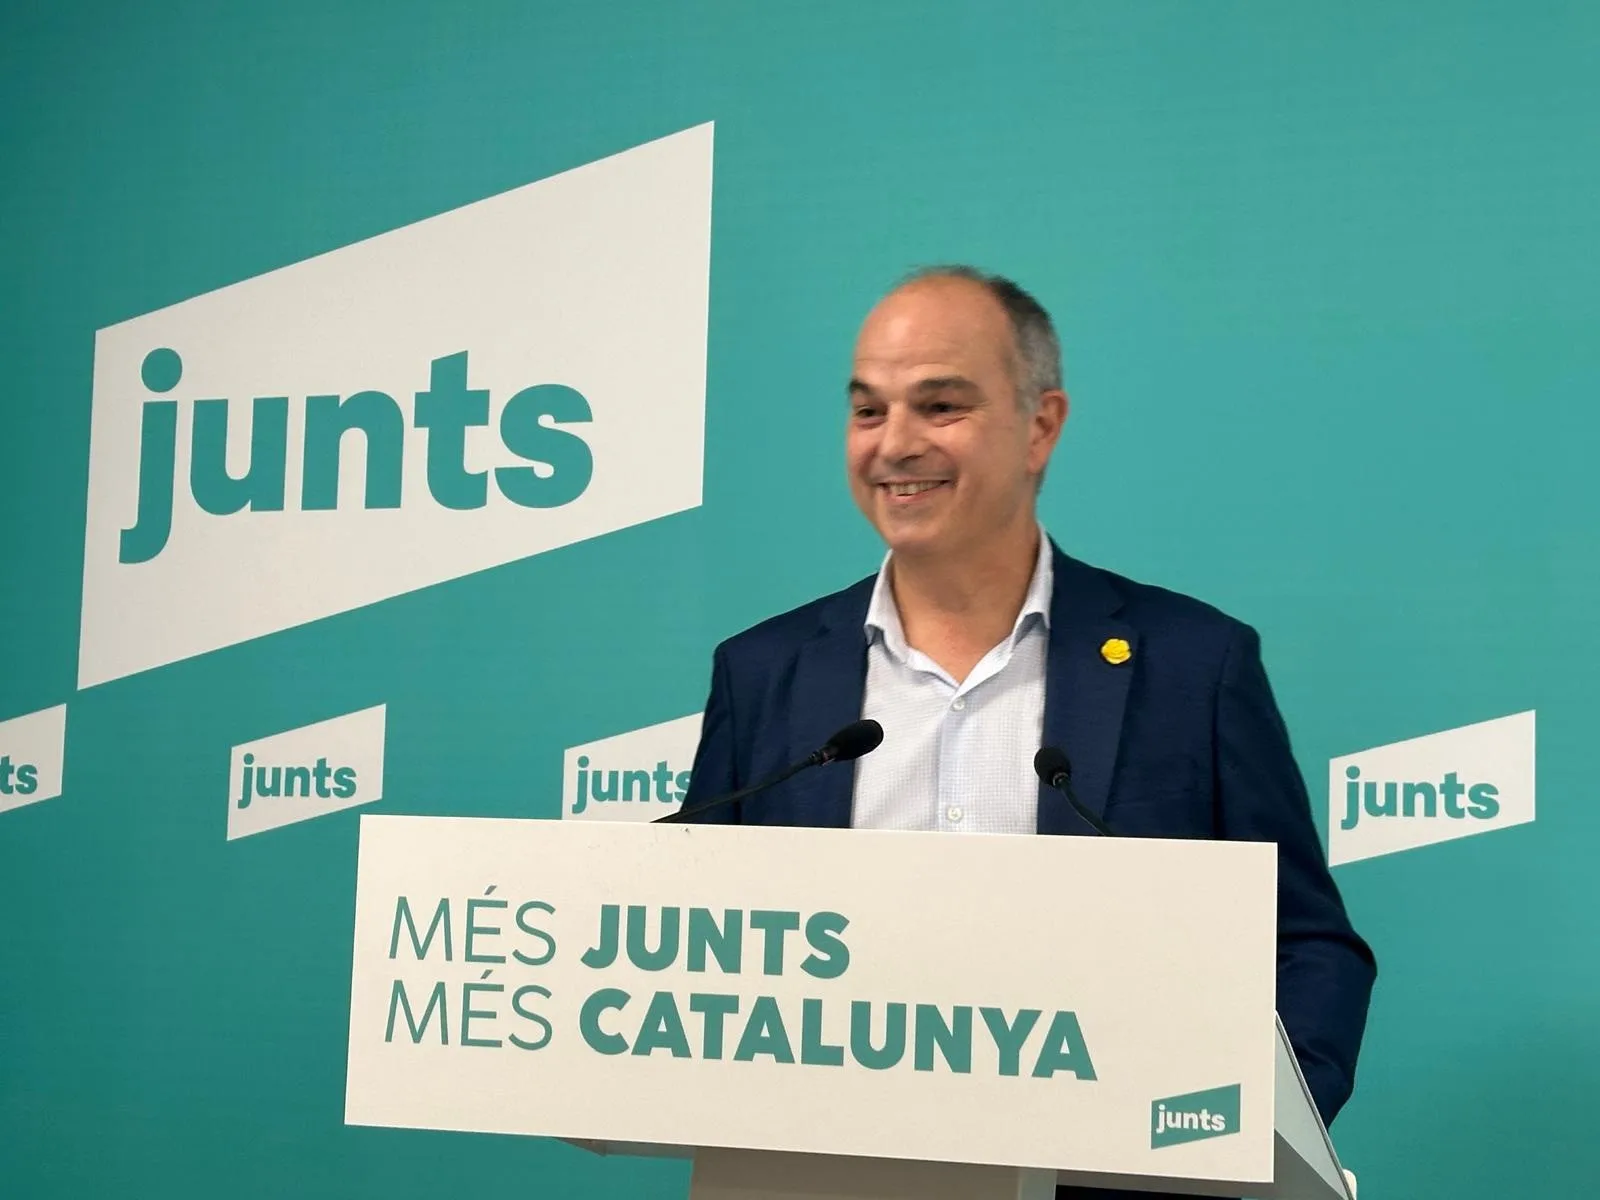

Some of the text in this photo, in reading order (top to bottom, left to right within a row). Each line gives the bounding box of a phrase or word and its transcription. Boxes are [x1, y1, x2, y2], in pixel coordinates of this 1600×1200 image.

[118, 346, 594, 566] junts
[237, 752, 357, 809] junts
[1340, 765, 1501, 830] junts
[388, 885, 851, 980] MÉS JUNTS
[384, 969, 1097, 1082] MÉS CATALUNYA
[1155, 1103, 1226, 1134] junts
